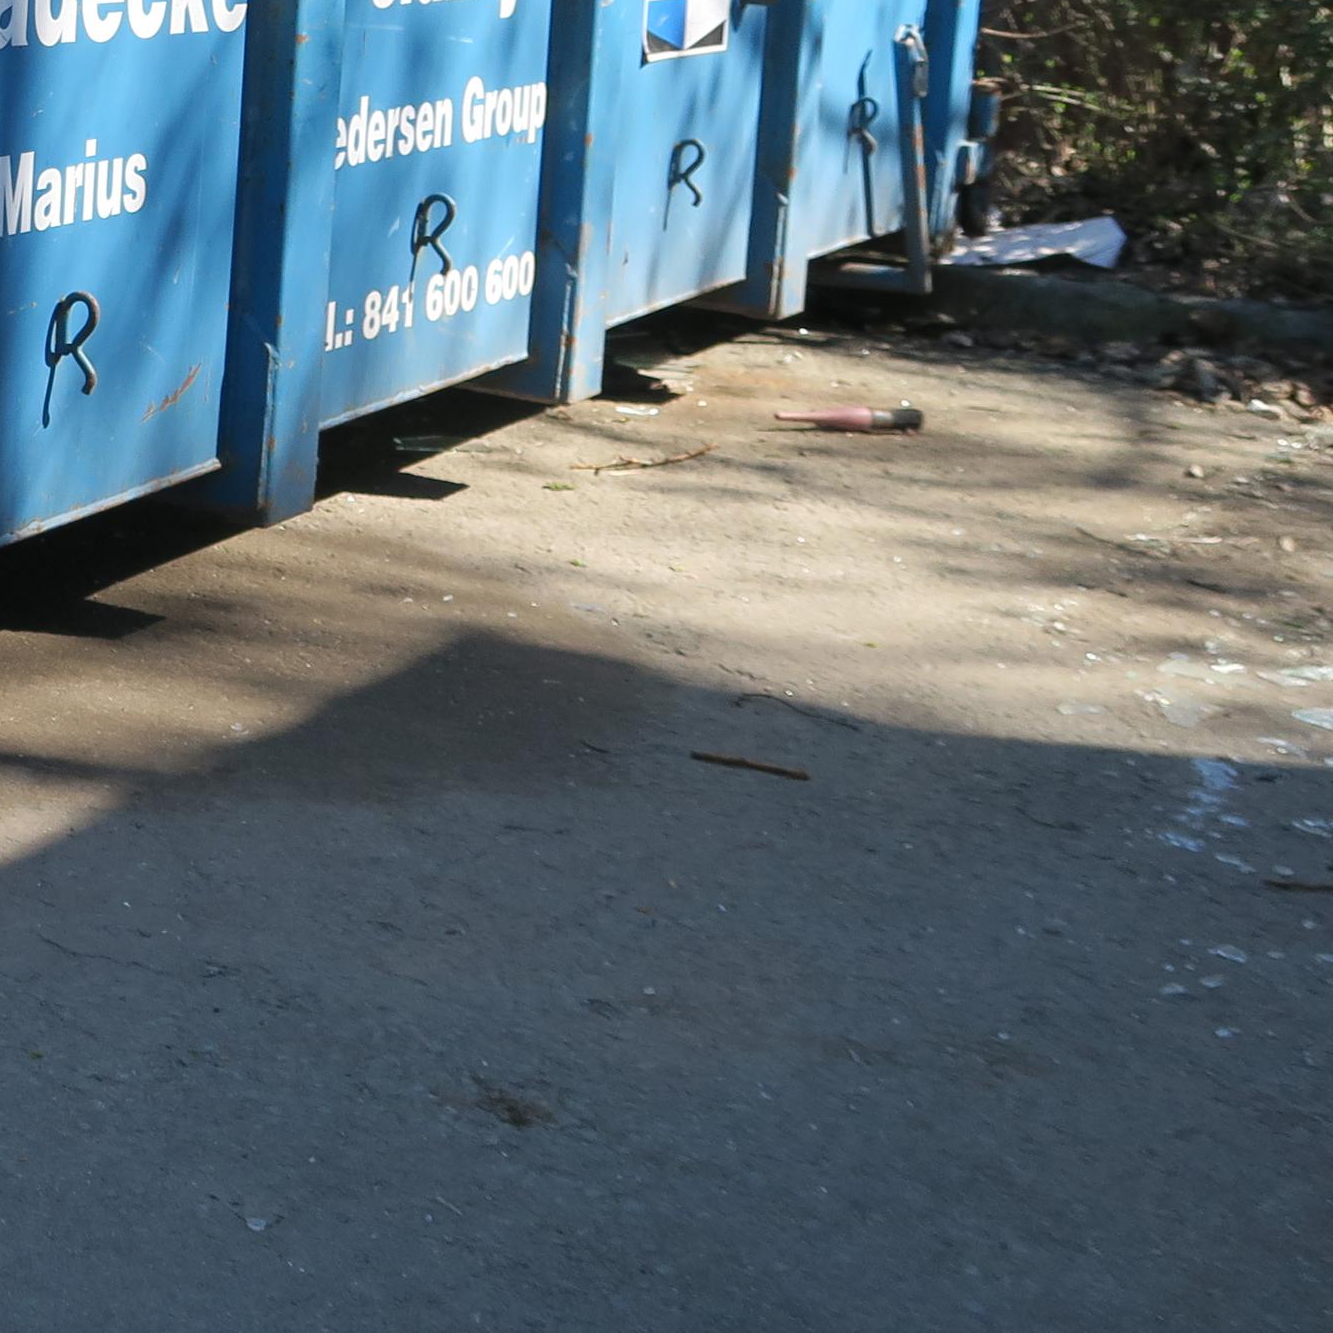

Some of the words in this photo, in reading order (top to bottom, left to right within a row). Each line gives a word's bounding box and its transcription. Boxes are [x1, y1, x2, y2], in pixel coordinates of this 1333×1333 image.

[461, 76, 547, 144] Group
[362, 285, 415, 340] 841
[425, 265, 479, 322] 600
[485, 251, 535, 306] 600
